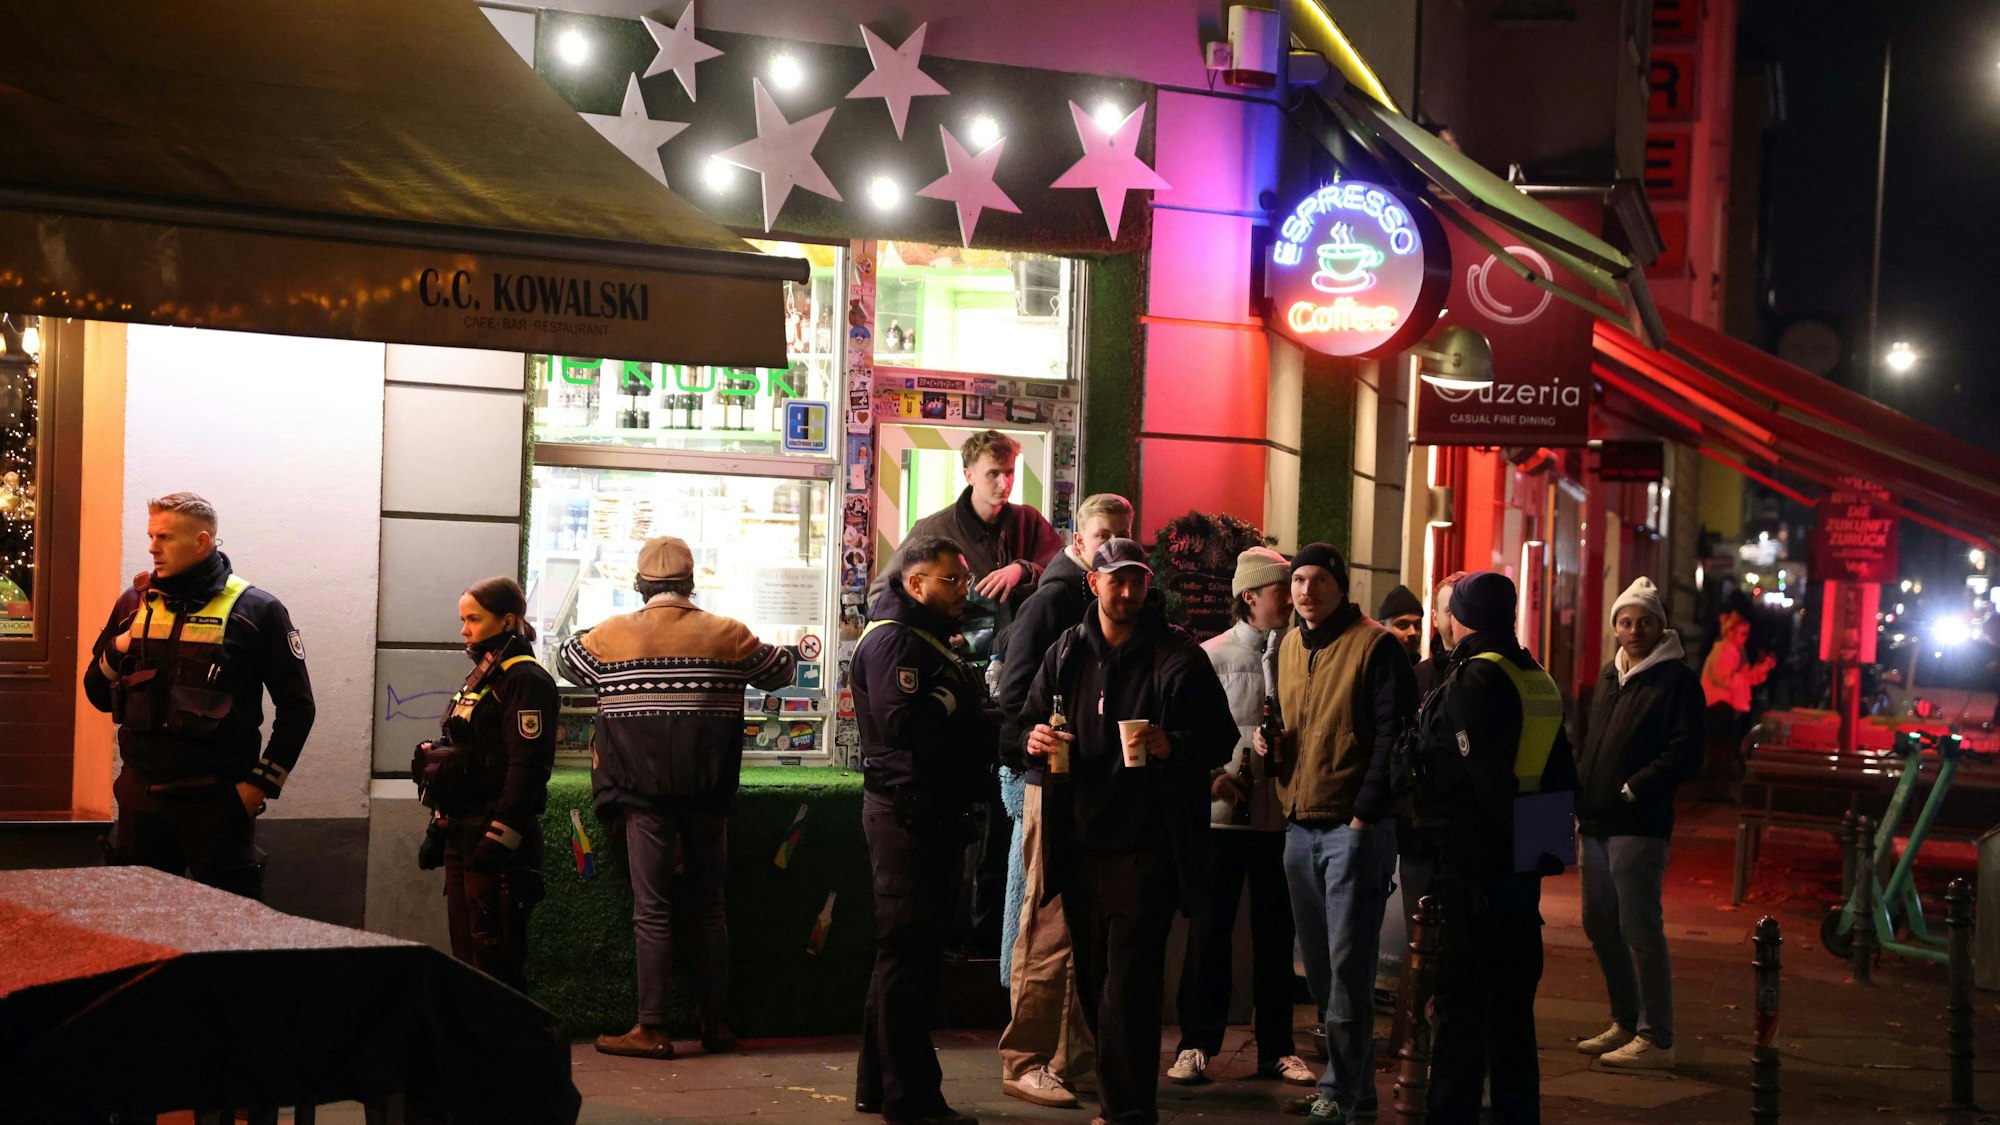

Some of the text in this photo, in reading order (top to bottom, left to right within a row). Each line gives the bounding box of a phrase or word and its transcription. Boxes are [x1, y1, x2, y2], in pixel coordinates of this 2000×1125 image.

[1274, 184, 1416, 265] ESPRESSO
[419, 268, 649, 321] C.C. KOWALSKI
[1288, 297, 1398, 333] Coffee
[1450, 413, 1556, 426] CASUAL FINE DINING
[789, 439, 812, 447] electronic
[1825, 519, 1893, 532] ZUKUNFT
